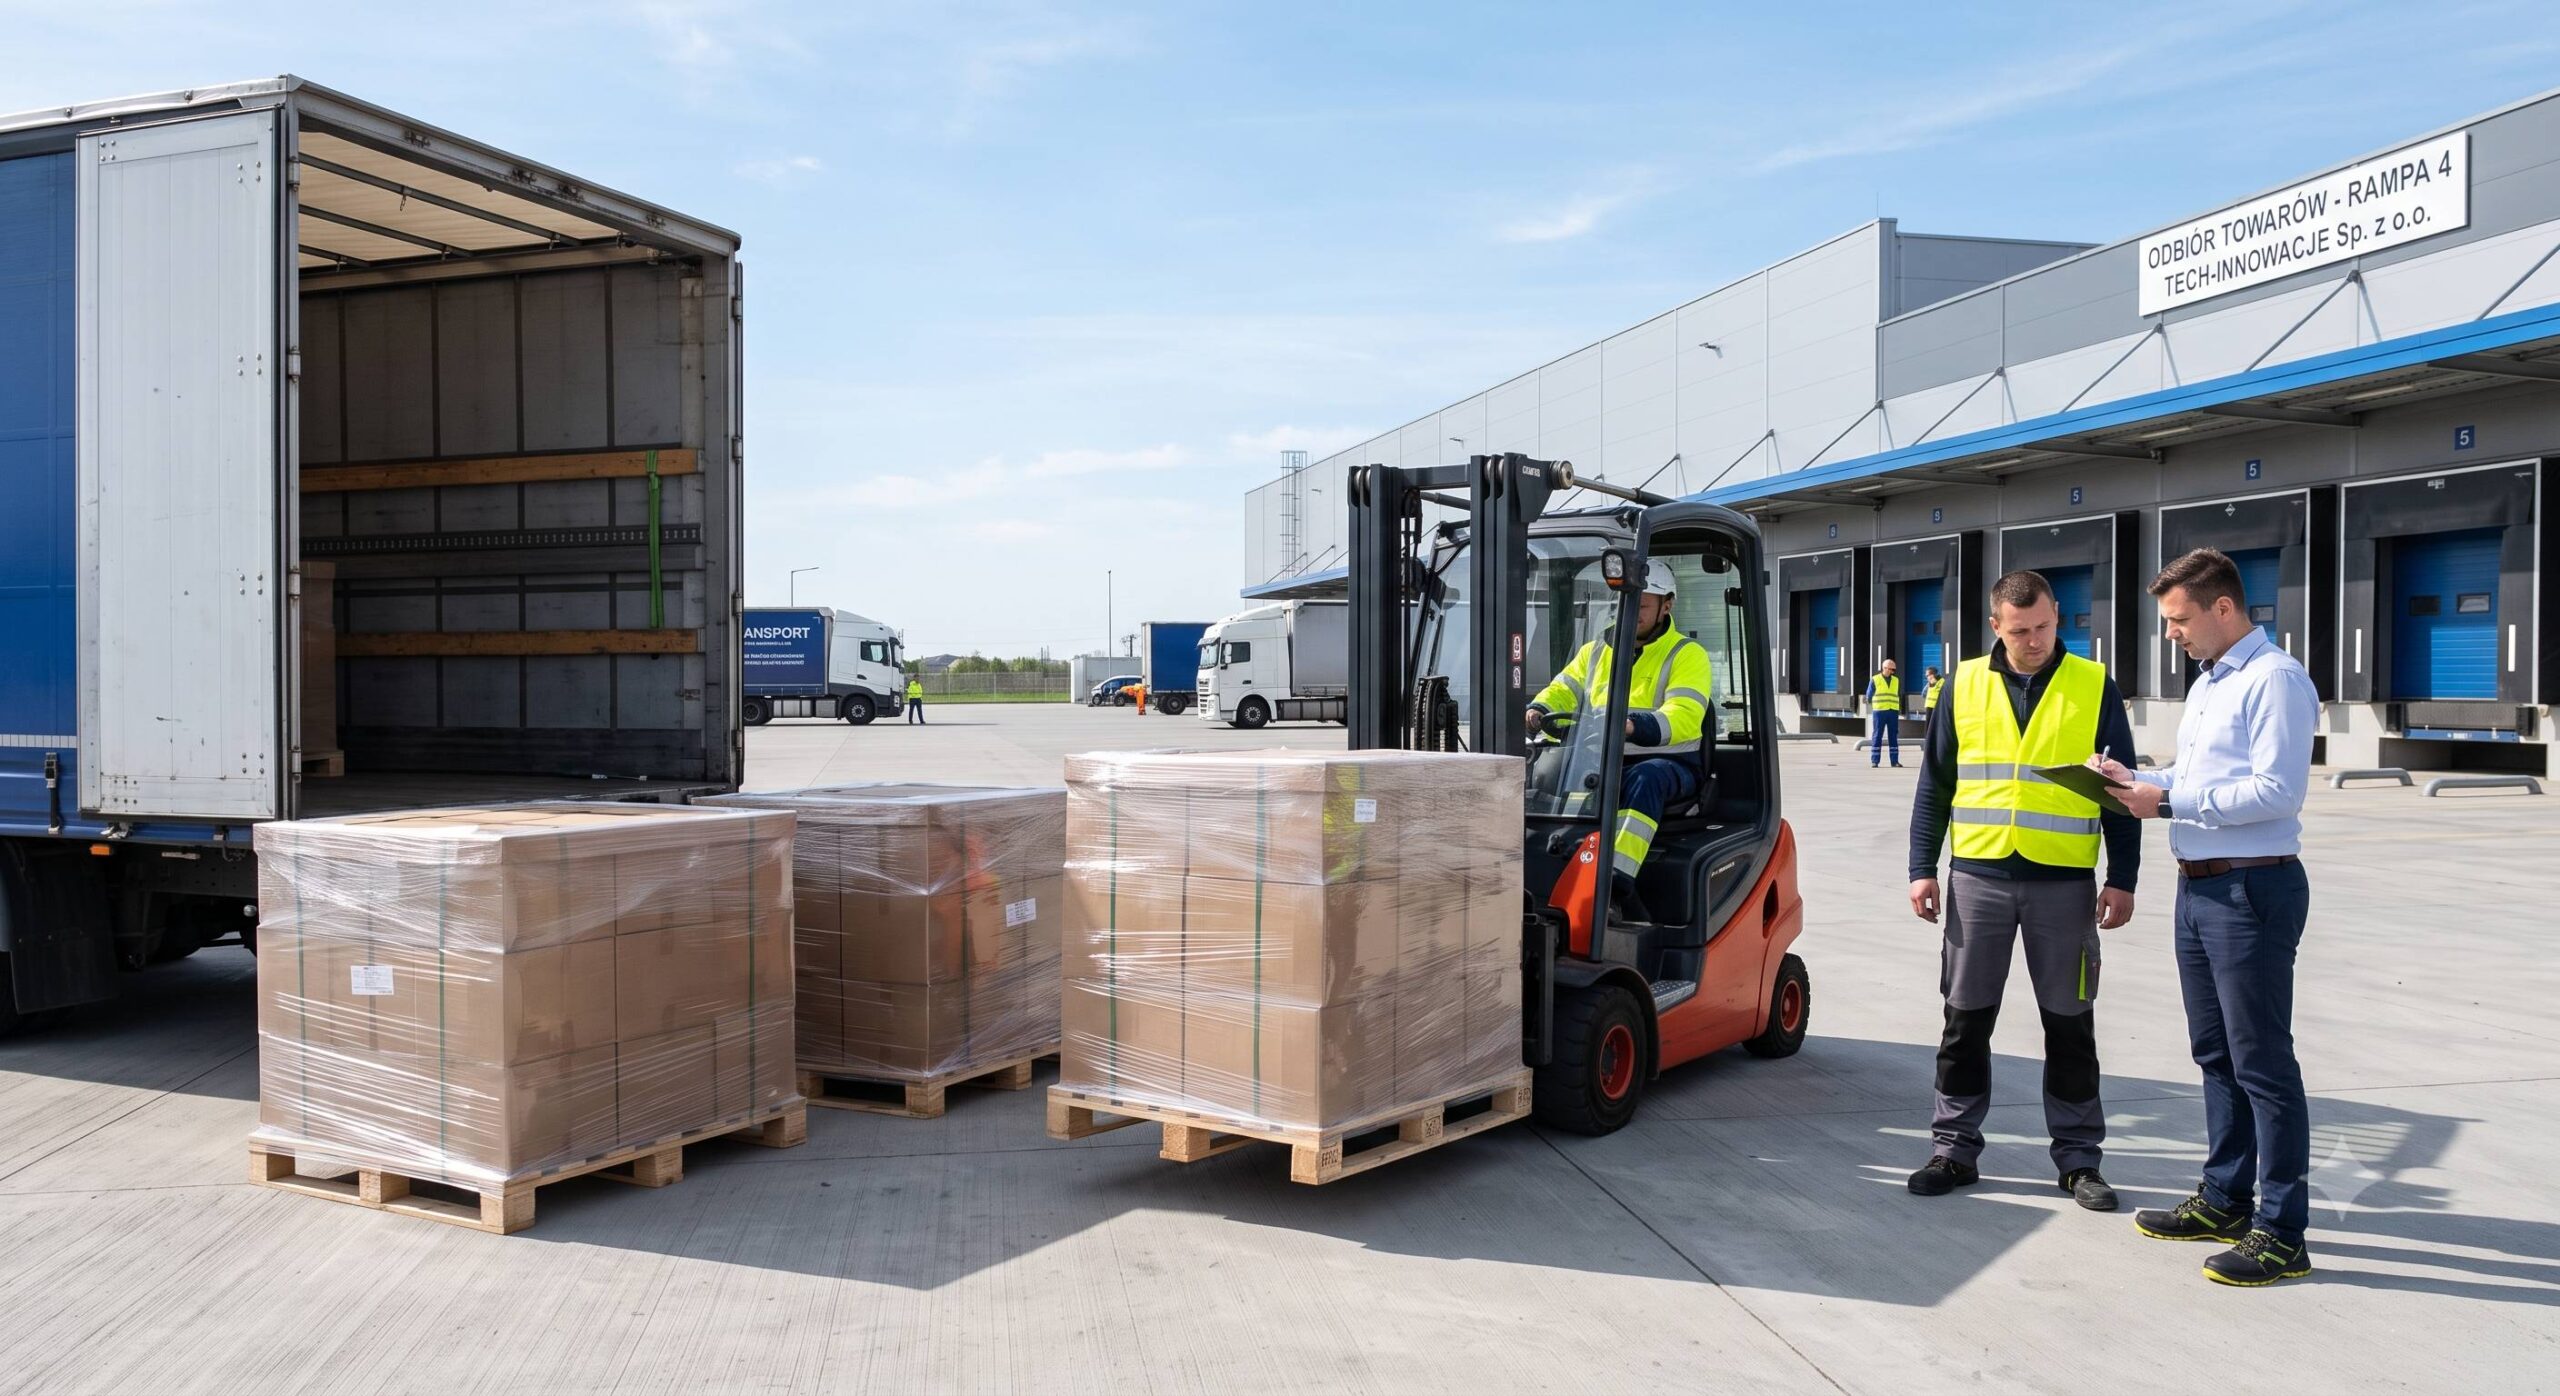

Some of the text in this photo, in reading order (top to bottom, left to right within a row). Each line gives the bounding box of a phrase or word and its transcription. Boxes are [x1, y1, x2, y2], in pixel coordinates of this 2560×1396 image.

[2148, 227, 2216, 269] ODBIÓR
[2221, 191, 2328, 246] TOWARÓW
[2348, 158, 2431, 208] RAMPA
[2438, 149, 2452, 177] 4
[2164, 206, 2431, 297] TECH-INNOWACJE Sp. z o.o.
[2459, 429, 2469, 446] 5
[2249, 463, 2257, 477] 5
[2073, 490, 2079, 502] 5
[743, 627, 810, 639] ANSPORT
